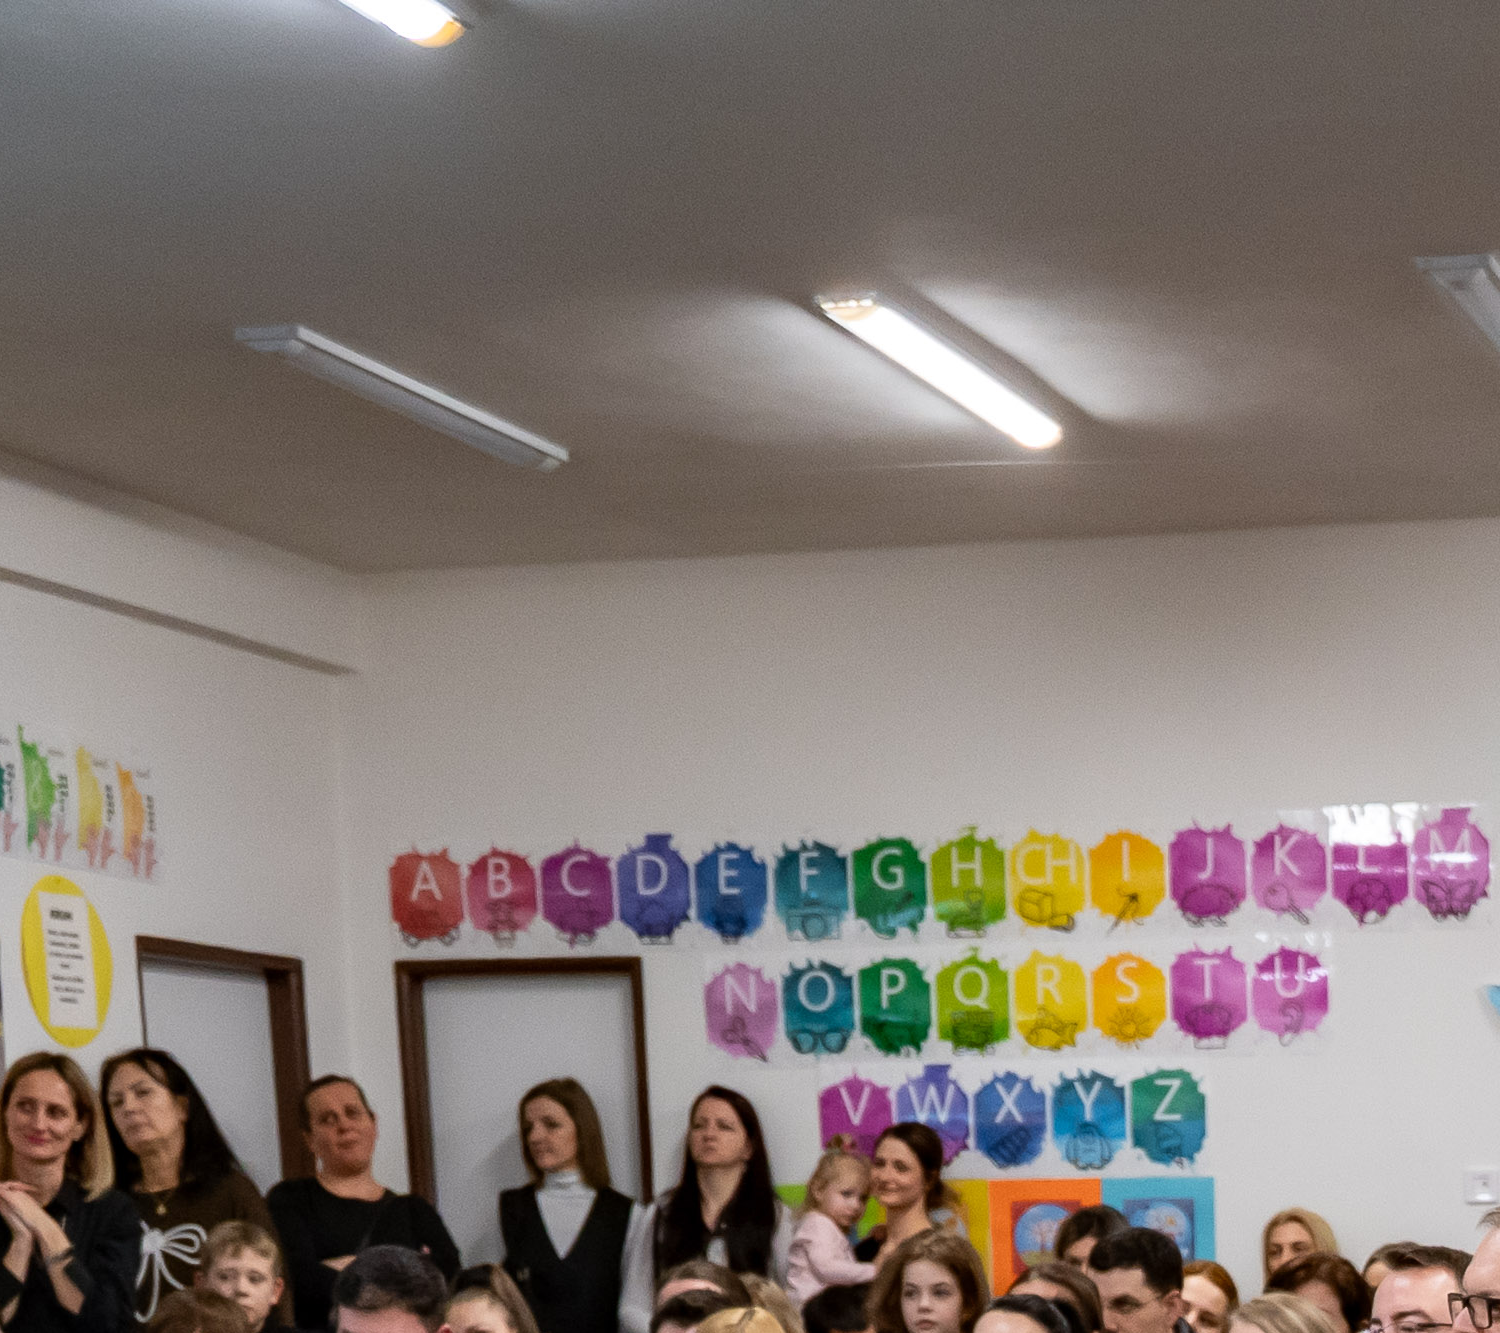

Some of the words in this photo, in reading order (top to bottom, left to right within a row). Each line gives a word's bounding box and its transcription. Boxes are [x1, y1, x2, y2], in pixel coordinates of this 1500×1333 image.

[411, 861, 443, 901] A
[487, 857, 513, 899] B
[560, 855, 591, 897] C
[636, 855, 668, 896] D
[717, 852, 741, 896] E
[800, 852, 819, 892] F
[872, 847, 905, 891] G
[951, 846, 983, 888] H
[1016, 840, 1077, 885] CH
[1122, 840, 1130, 882] I
[1198, 837, 1214, 880] J
[1275, 833, 1300, 876] K
[1358, 845, 1379, 873] L
[1429, 829, 1472, 872] M
[724, 973, 757, 1015] N
[798, 970, 836, 1013] O
[880, 967, 907, 1010] P
[953, 965, 990, 1010] Q
[1035, 964, 1064, 1005] R
[1115, 960, 1140, 1003] S
[1193, 957, 1220, 1001] T
[1273, 955, 1305, 998] U
[839, 1086, 871, 1127] V
[908, 1082, 956, 1126] W
[995, 1081, 1023, 1124] X
[1073, 1081, 1102, 1121] Y
[1153, 1078, 1183, 1122] Z
